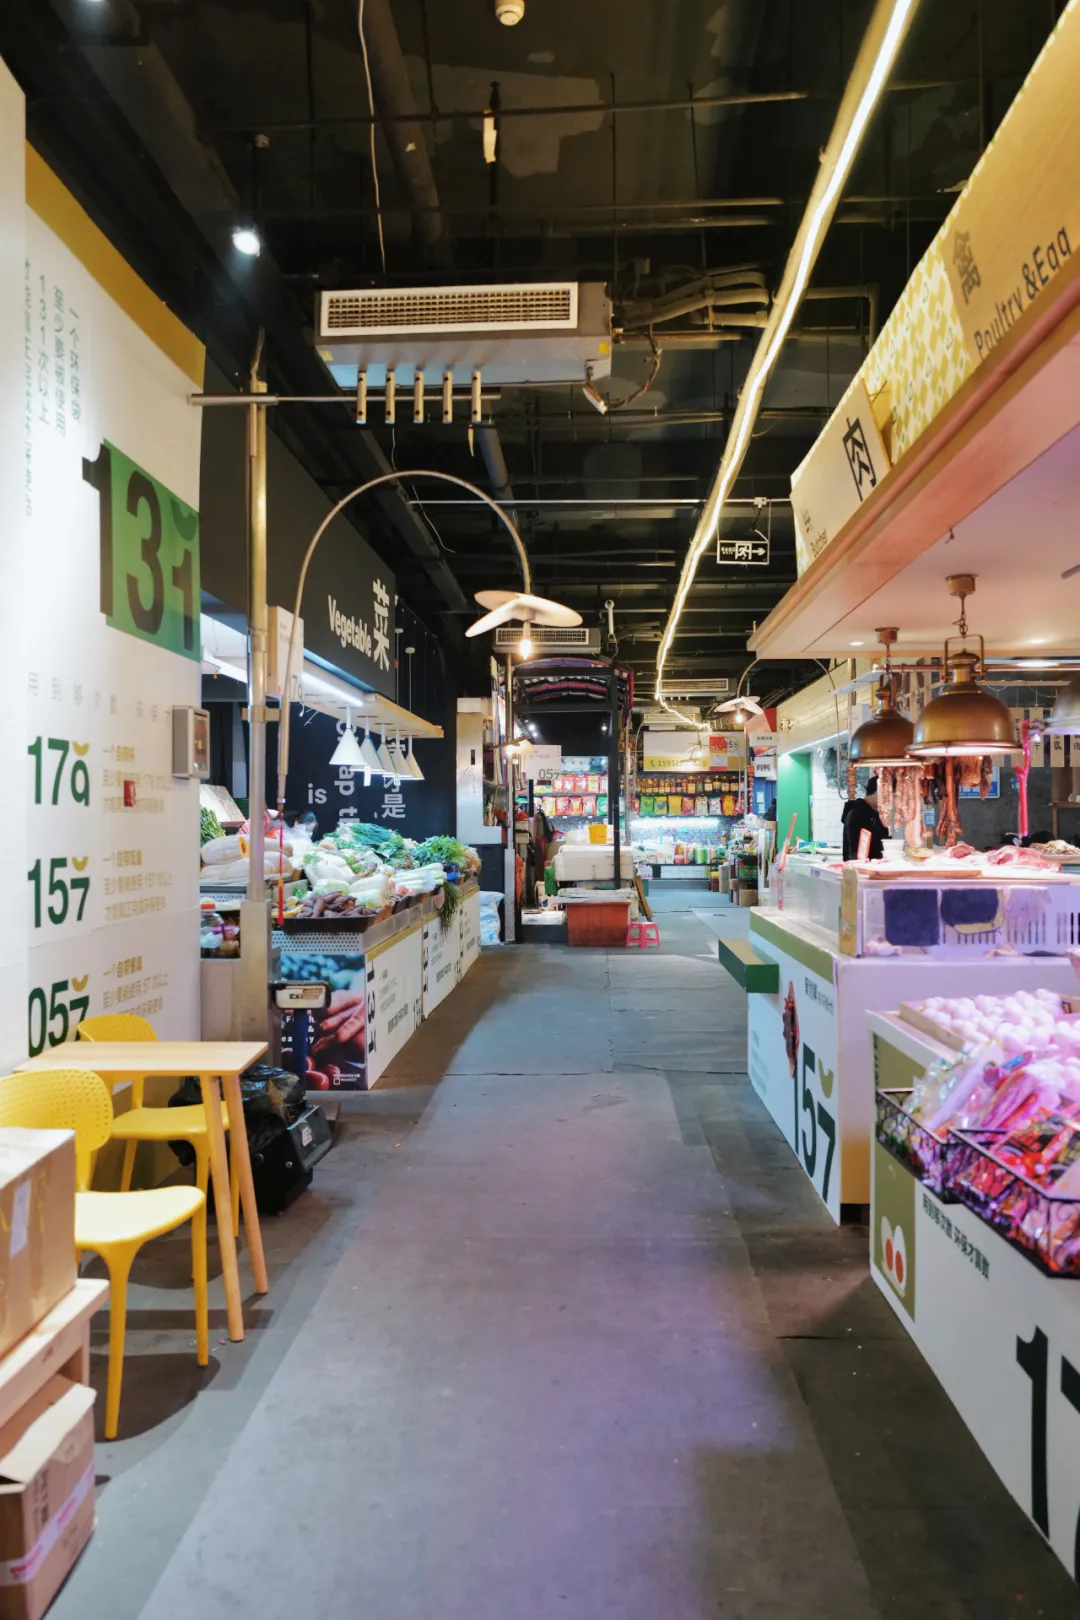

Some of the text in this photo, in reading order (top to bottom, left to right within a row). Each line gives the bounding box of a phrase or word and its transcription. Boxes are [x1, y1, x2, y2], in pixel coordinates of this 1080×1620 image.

[842, 417, 877, 501] 肉
[82, 443, 196, 652] 131
[328, 594, 372, 659] Vegetable
[372, 578, 390, 672] 菜
[308, 783, 327, 804] is
[538, 768, 561, 781] 057
[27, 857, 90, 929] 157
[28, 980, 91, 1059] 057
